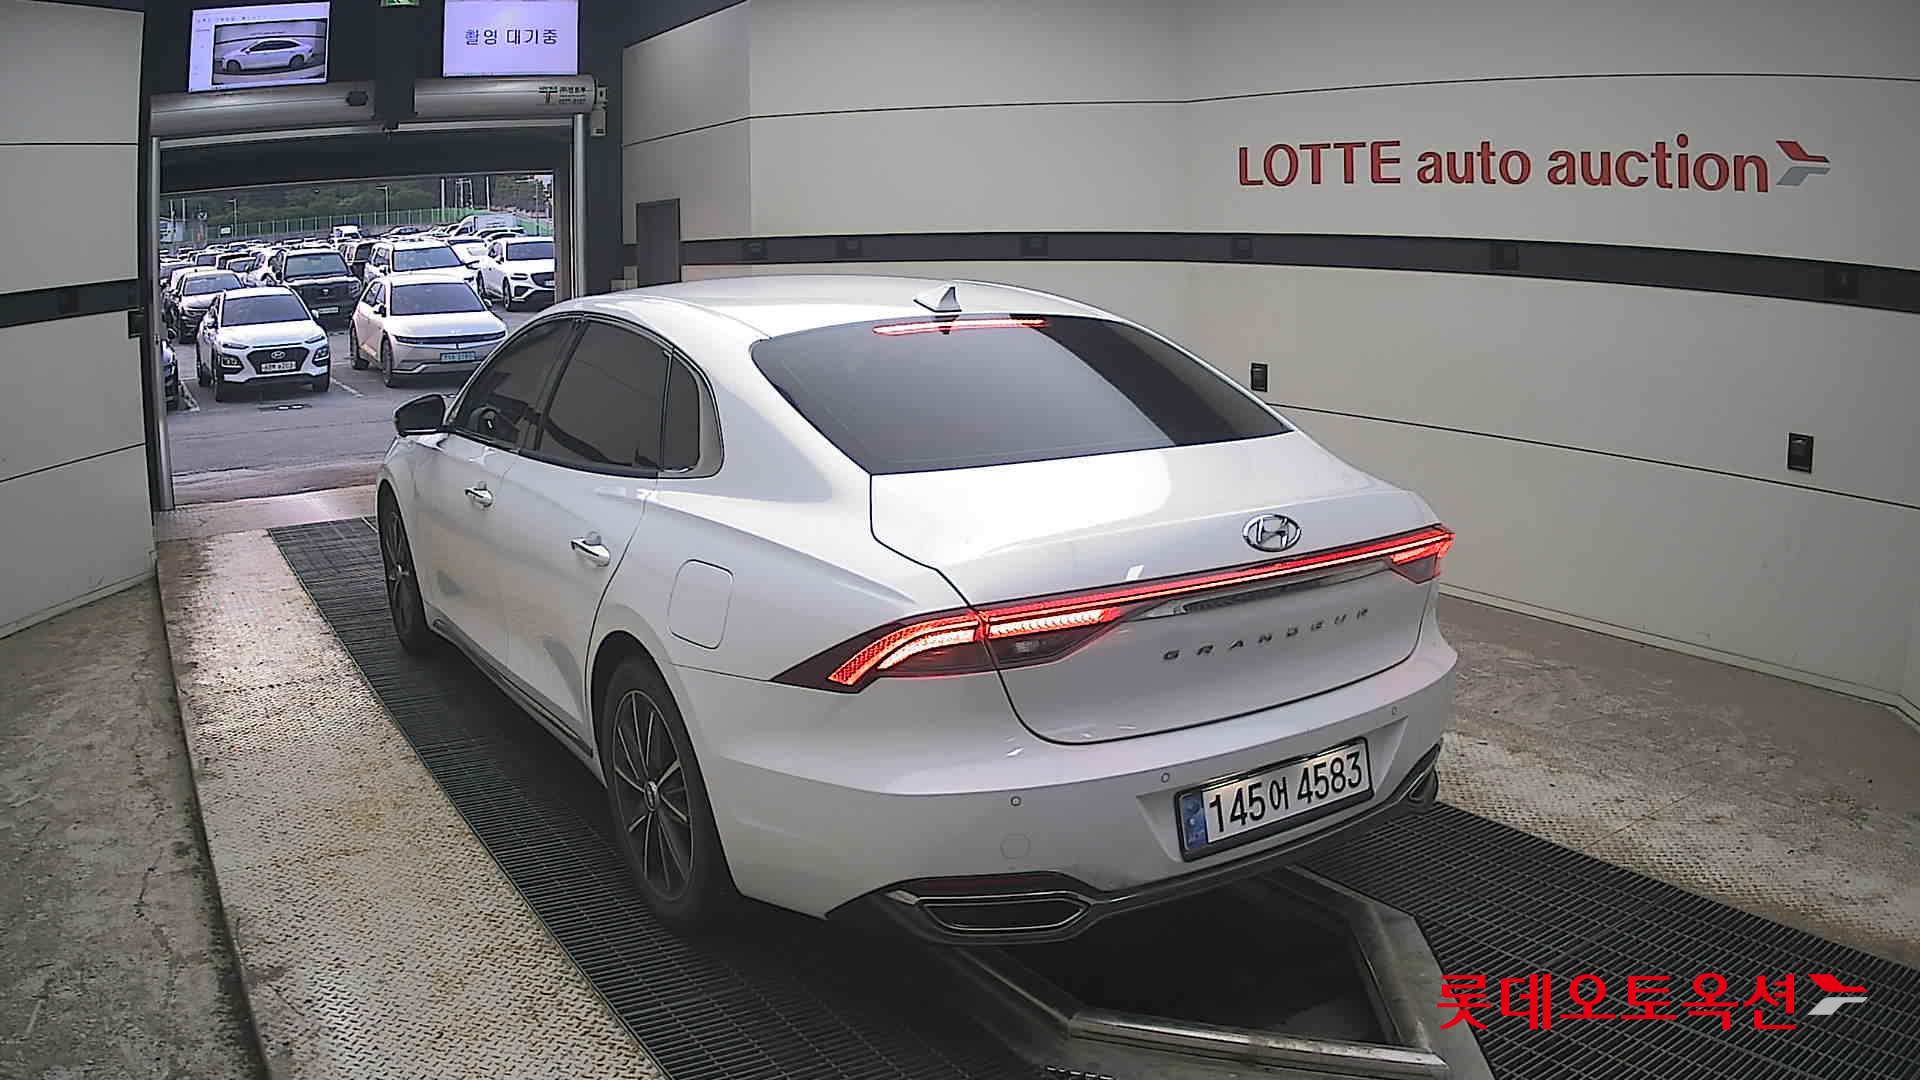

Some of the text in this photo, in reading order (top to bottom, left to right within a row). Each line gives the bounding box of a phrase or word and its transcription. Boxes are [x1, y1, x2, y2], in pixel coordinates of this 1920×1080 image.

[465, 29, 558, 45] 촬영 대기중
[1238, 133, 1770, 193] LOTTE auto auction
[1162, 608, 1369, 661] GRANDEUR
[1208, 751, 1363, 833] 145어 4583
